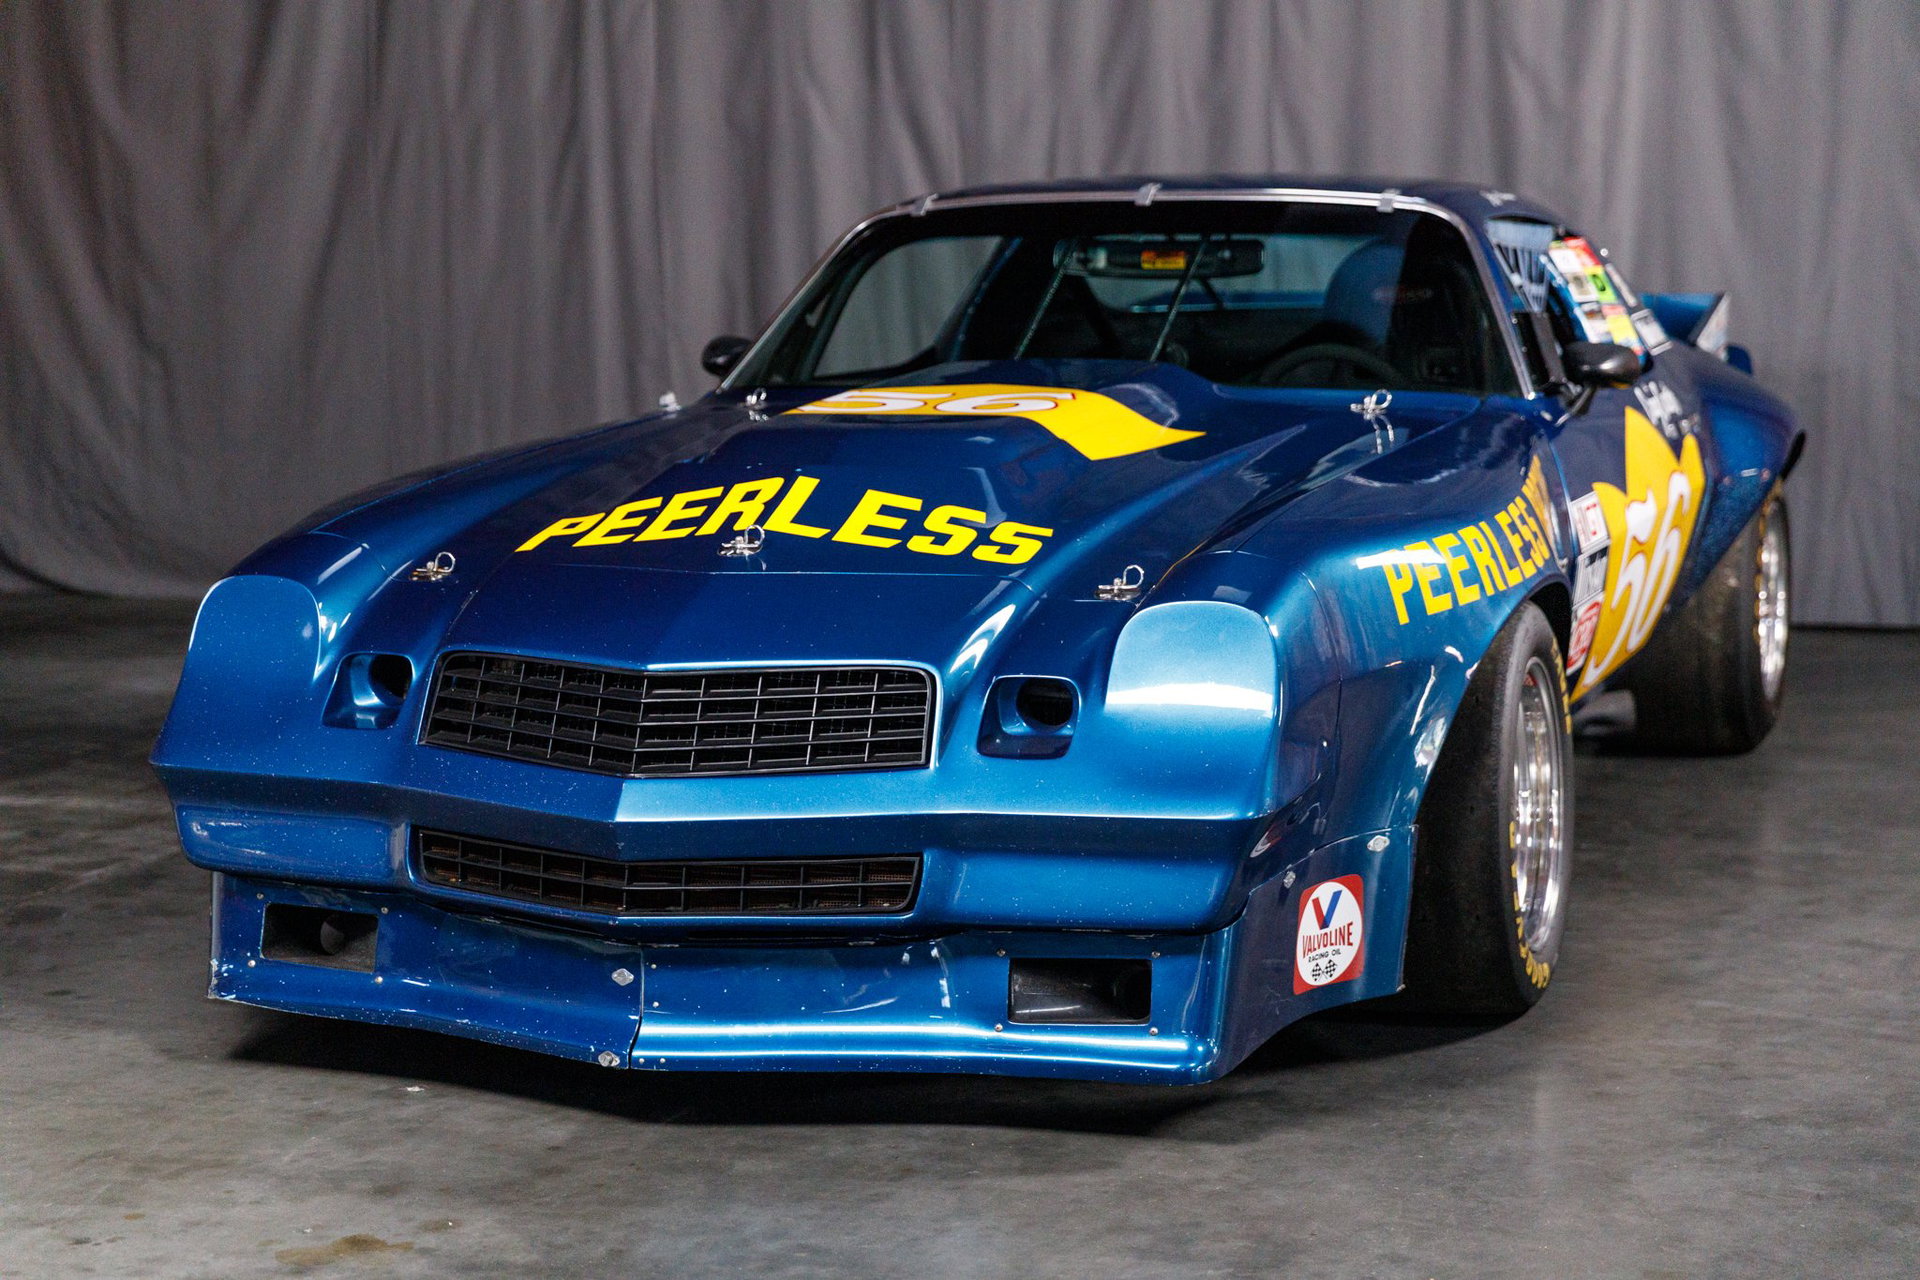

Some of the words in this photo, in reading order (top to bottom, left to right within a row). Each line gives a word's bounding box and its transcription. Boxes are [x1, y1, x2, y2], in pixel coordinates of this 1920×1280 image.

[797, 388, 1076, 413] 56
[515, 475, 1054, 566] PEERLESS
[1382, 496, 1551, 625] PEERLESS
[1583, 470, 1691, 686] 56
[1302, 921, 1354, 959] VALVOLINE
[1308, 950, 1329, 963] RACING
